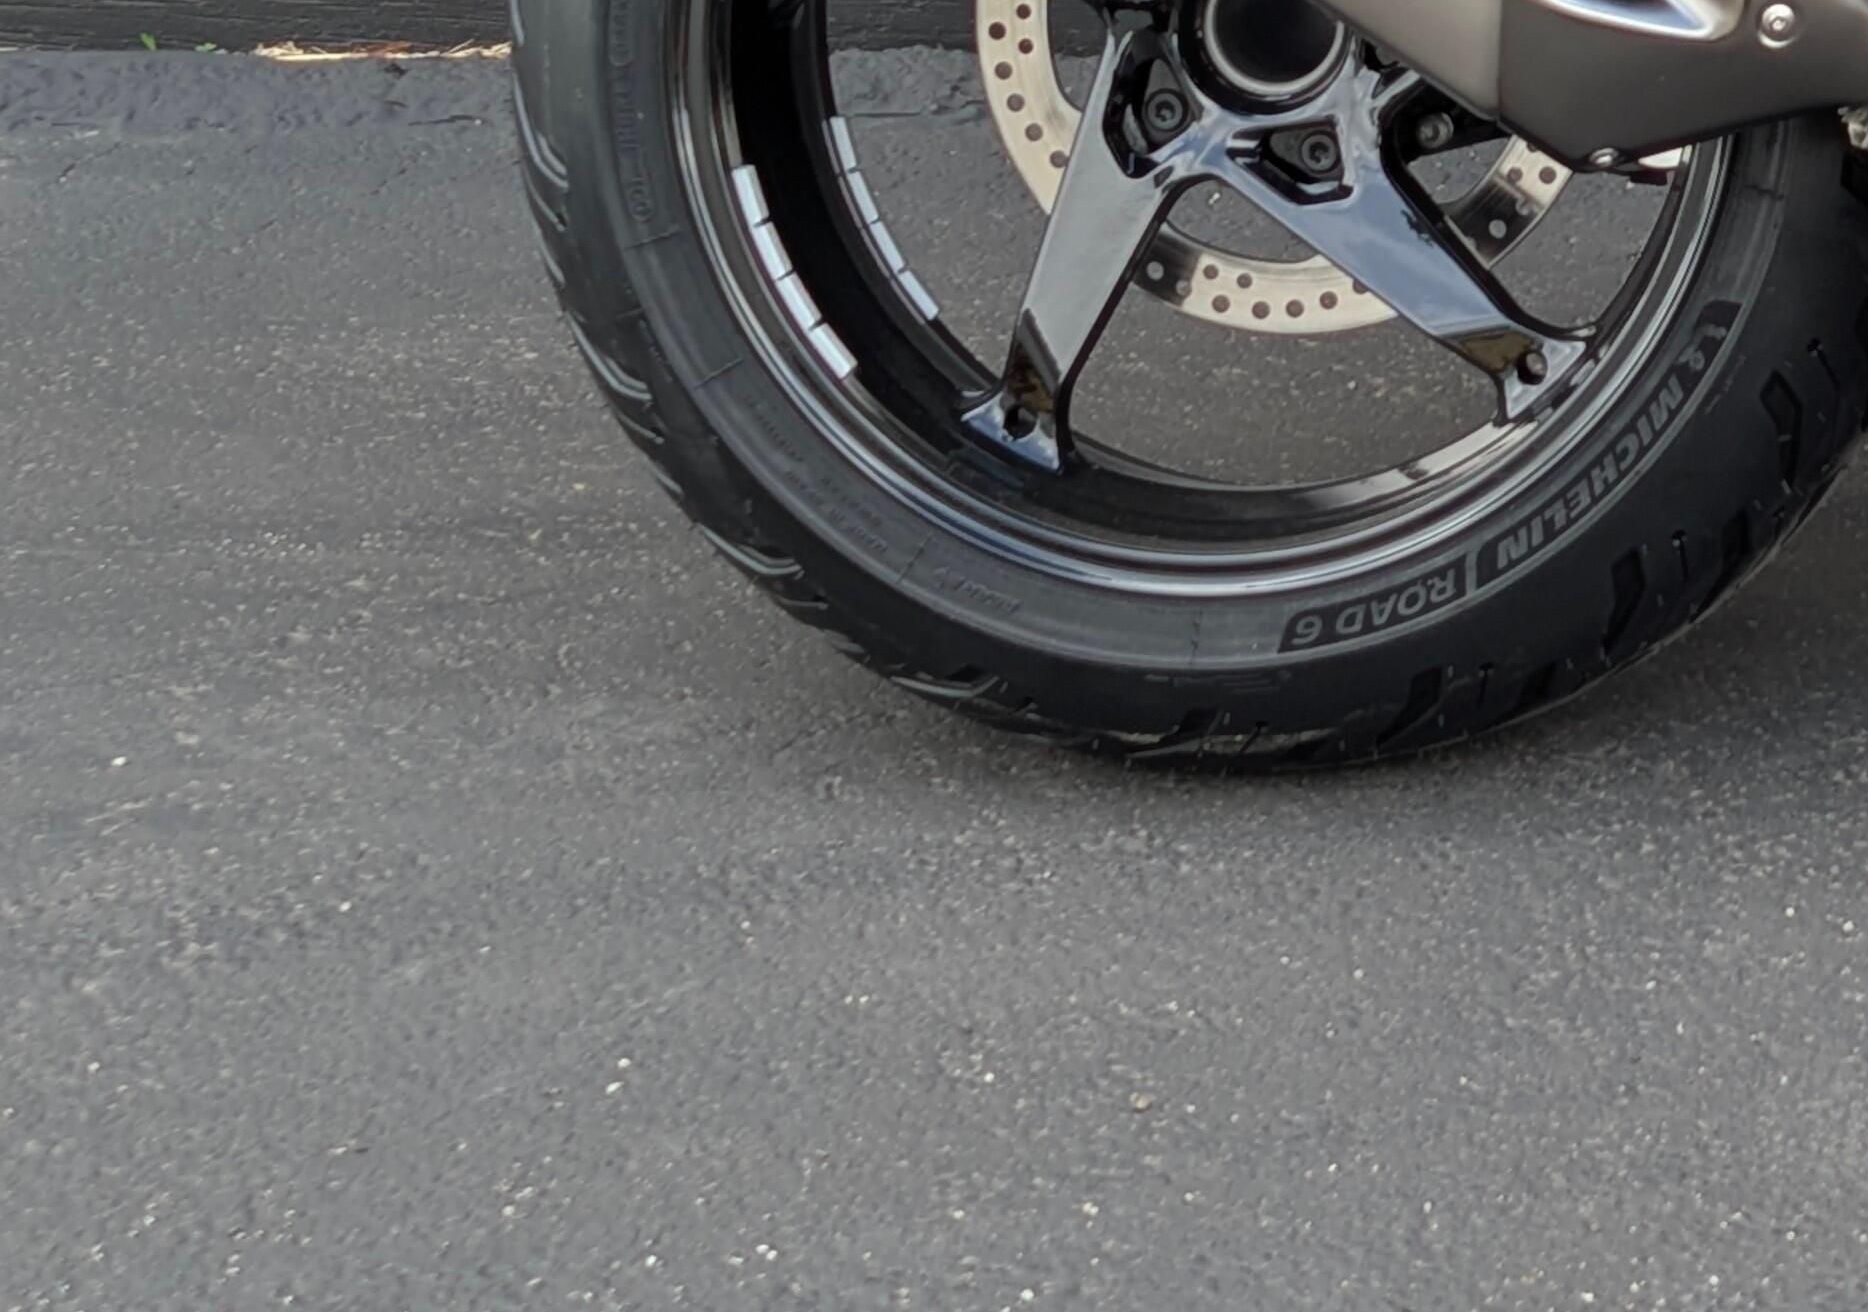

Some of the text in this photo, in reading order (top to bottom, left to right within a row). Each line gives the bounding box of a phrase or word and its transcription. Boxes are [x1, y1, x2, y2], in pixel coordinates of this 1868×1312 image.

[1291, 377, 1686, 646] MICHELIN ROAD 6
